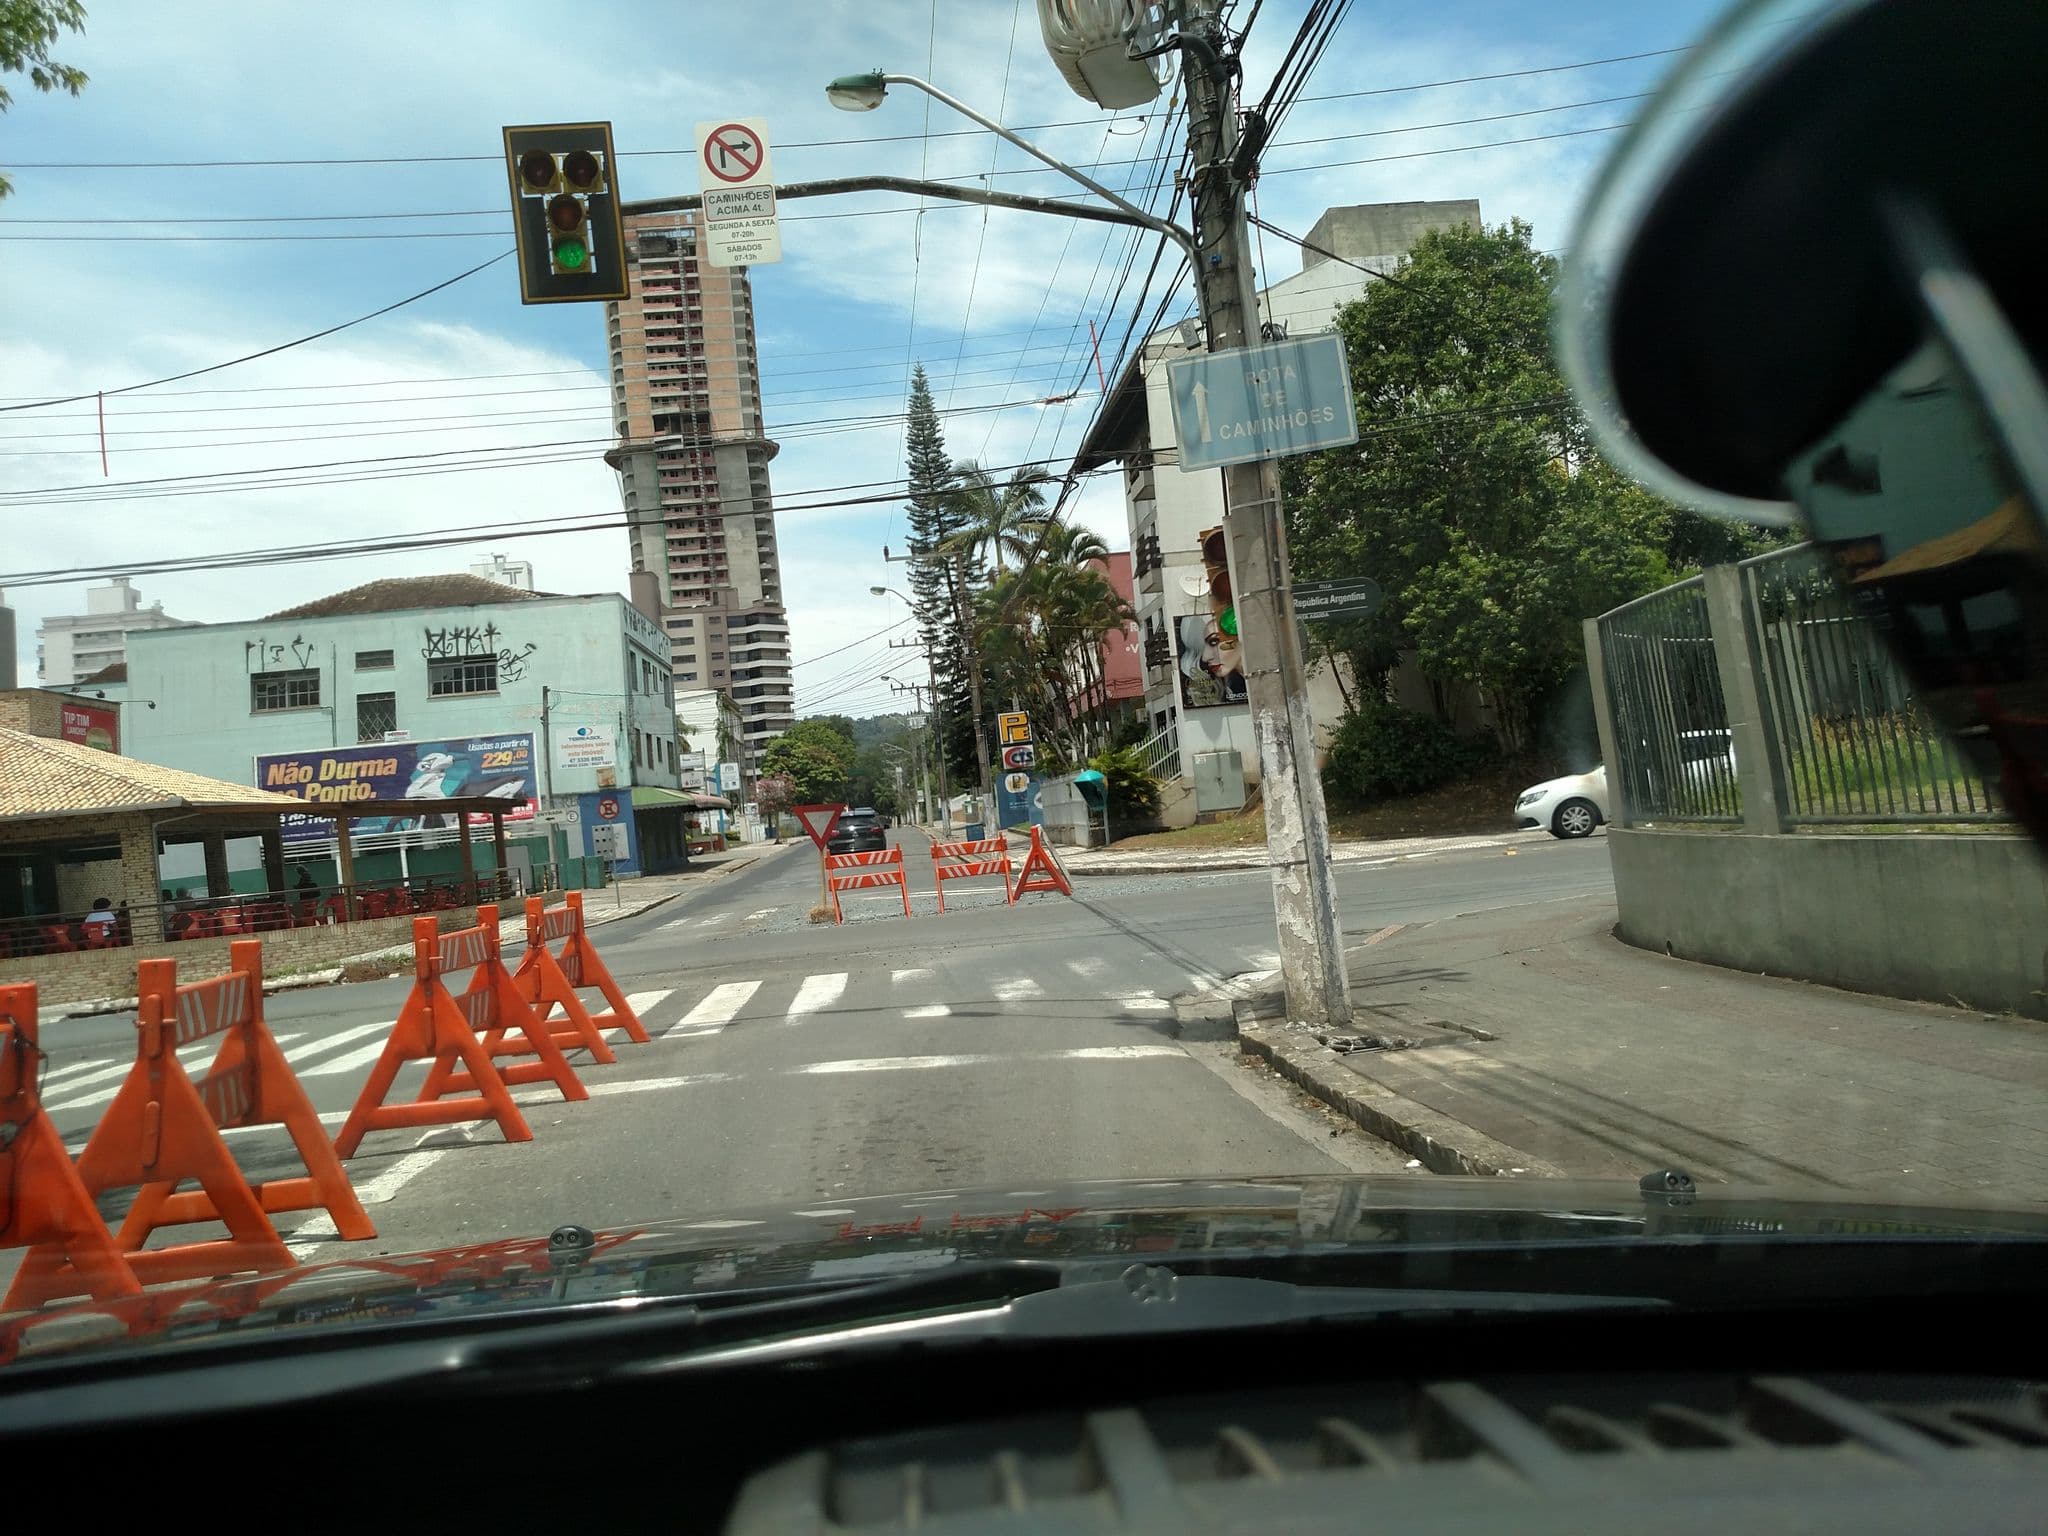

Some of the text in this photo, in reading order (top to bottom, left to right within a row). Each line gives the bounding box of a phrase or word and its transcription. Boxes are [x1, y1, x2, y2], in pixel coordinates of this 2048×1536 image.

[717, 205, 750, 215] ACIMA
[708, 222, 744, 231] SEGUNDA
[752, 219, 775, 227] SEXTA
[1246, 365, 1296, 385] ROTA
[1262, 390, 1287, 408] DE
[1219, 406, 1334, 440] CAMINHÕES
[1292, 592, 1366, 608] República Argentina
[64, 711, 89, 727] TIP TIM
[468, 742, 493, 751] Usadas
[266, 758, 397, 786] Não Durma
[304, 780, 377, 802] Ponto.
